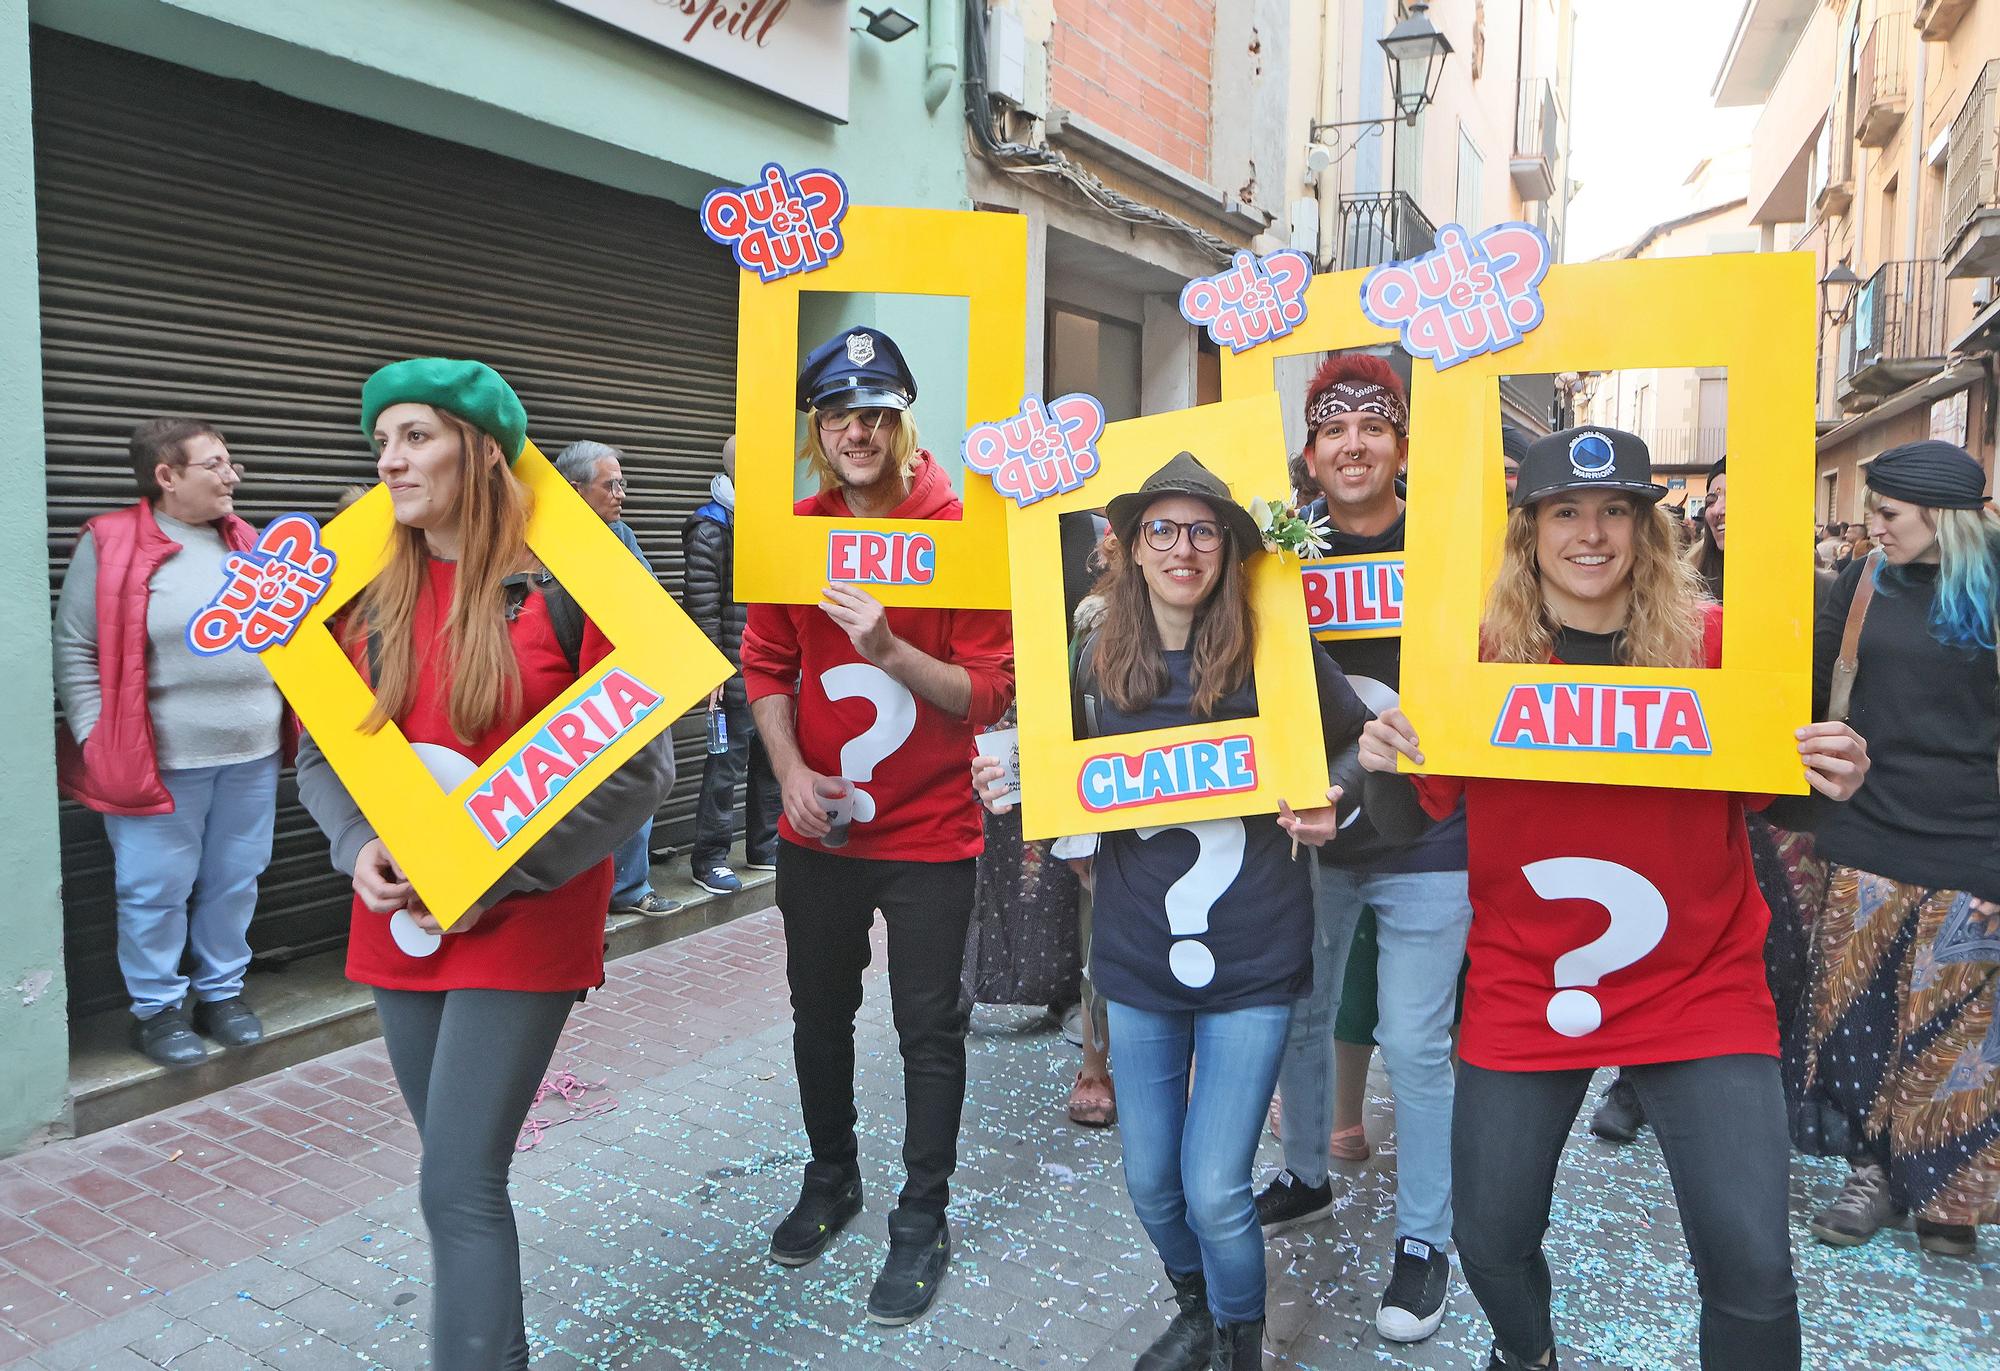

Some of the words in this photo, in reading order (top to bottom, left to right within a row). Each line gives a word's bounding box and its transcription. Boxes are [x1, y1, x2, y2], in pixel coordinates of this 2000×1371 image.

[655, 0, 791, 48] spill
[1572, 464, 1617, 479] WARRIORS
[831, 534, 932, 582] ERIC
[1302, 567, 1404, 625] BILL
[1497, 686, 1708, 749] ANITA
[468, 671, 660, 844] MARIA
[1082, 740, 1253, 807] CLAIRE
